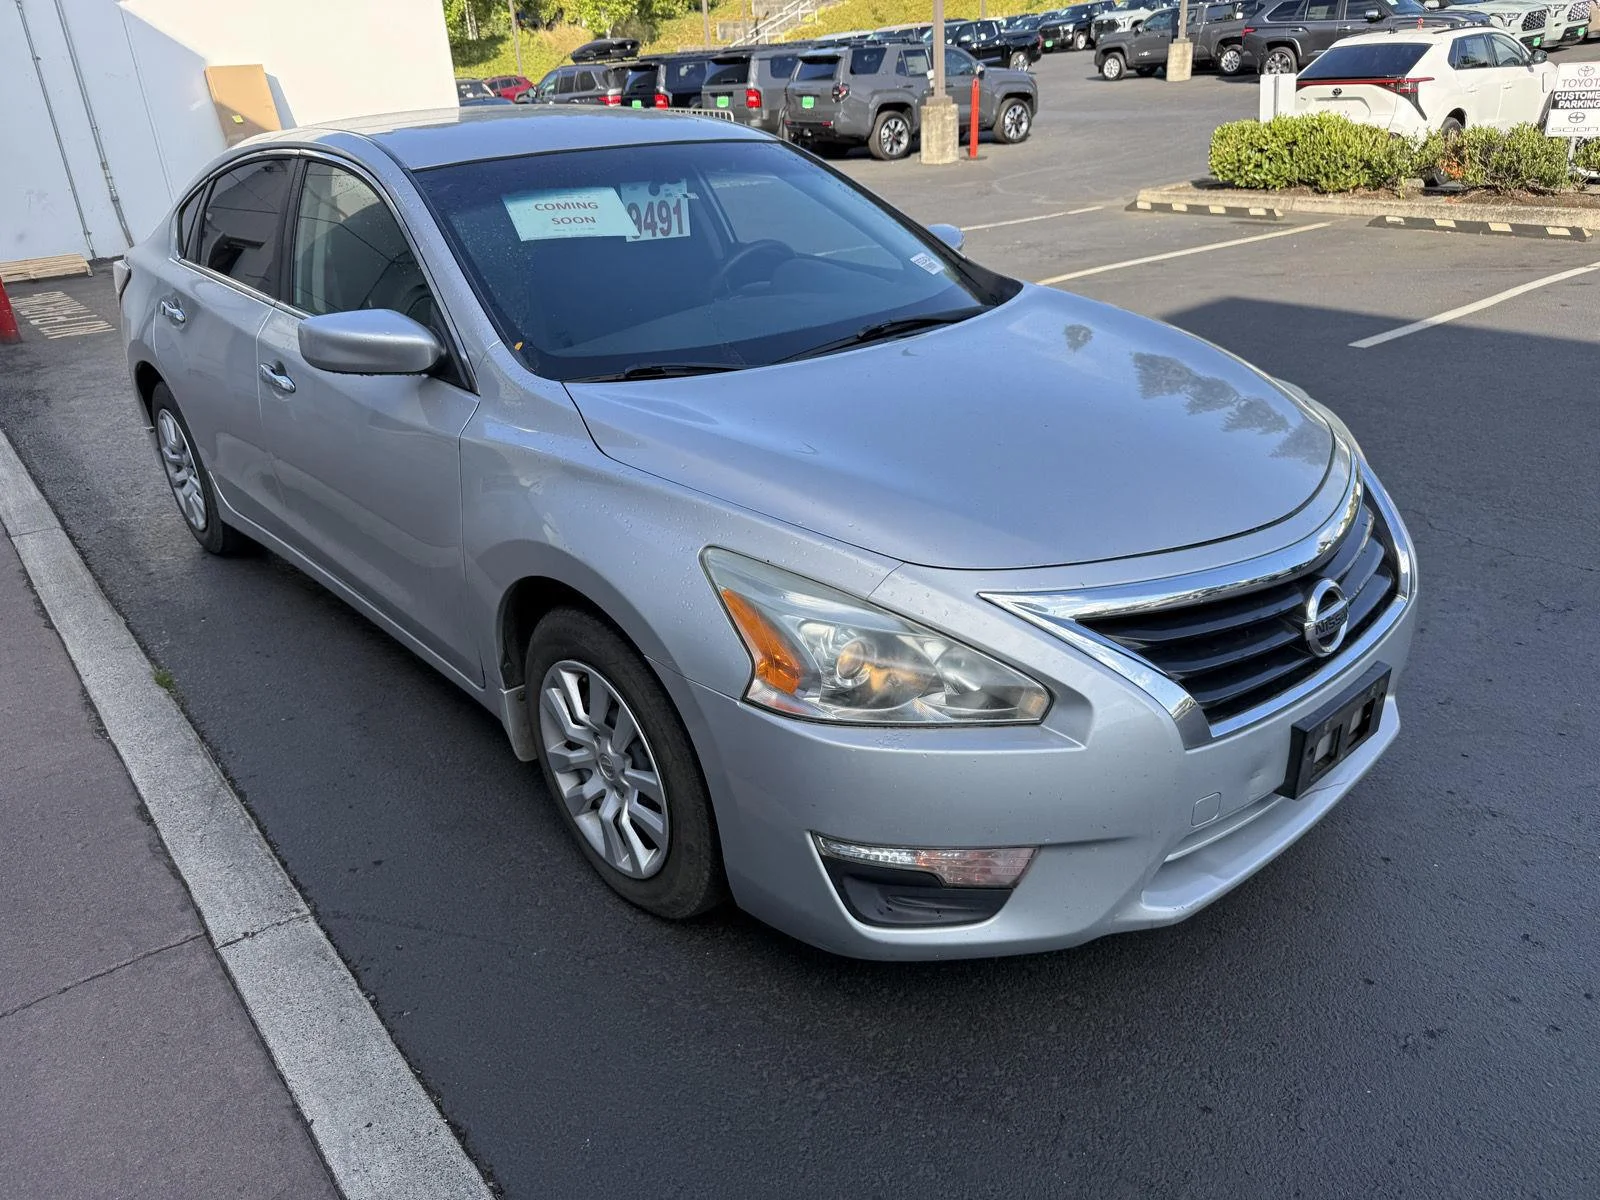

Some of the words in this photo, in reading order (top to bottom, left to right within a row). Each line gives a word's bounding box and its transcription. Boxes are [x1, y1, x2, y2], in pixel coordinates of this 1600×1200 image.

[1562, 78, 1600, 88] TOYOT
[1558, 100, 1600, 109] PARKING
[534, 201, 599, 212] COMING
[552, 216, 596, 226] SOON
[627, 200, 684, 239] 9491
